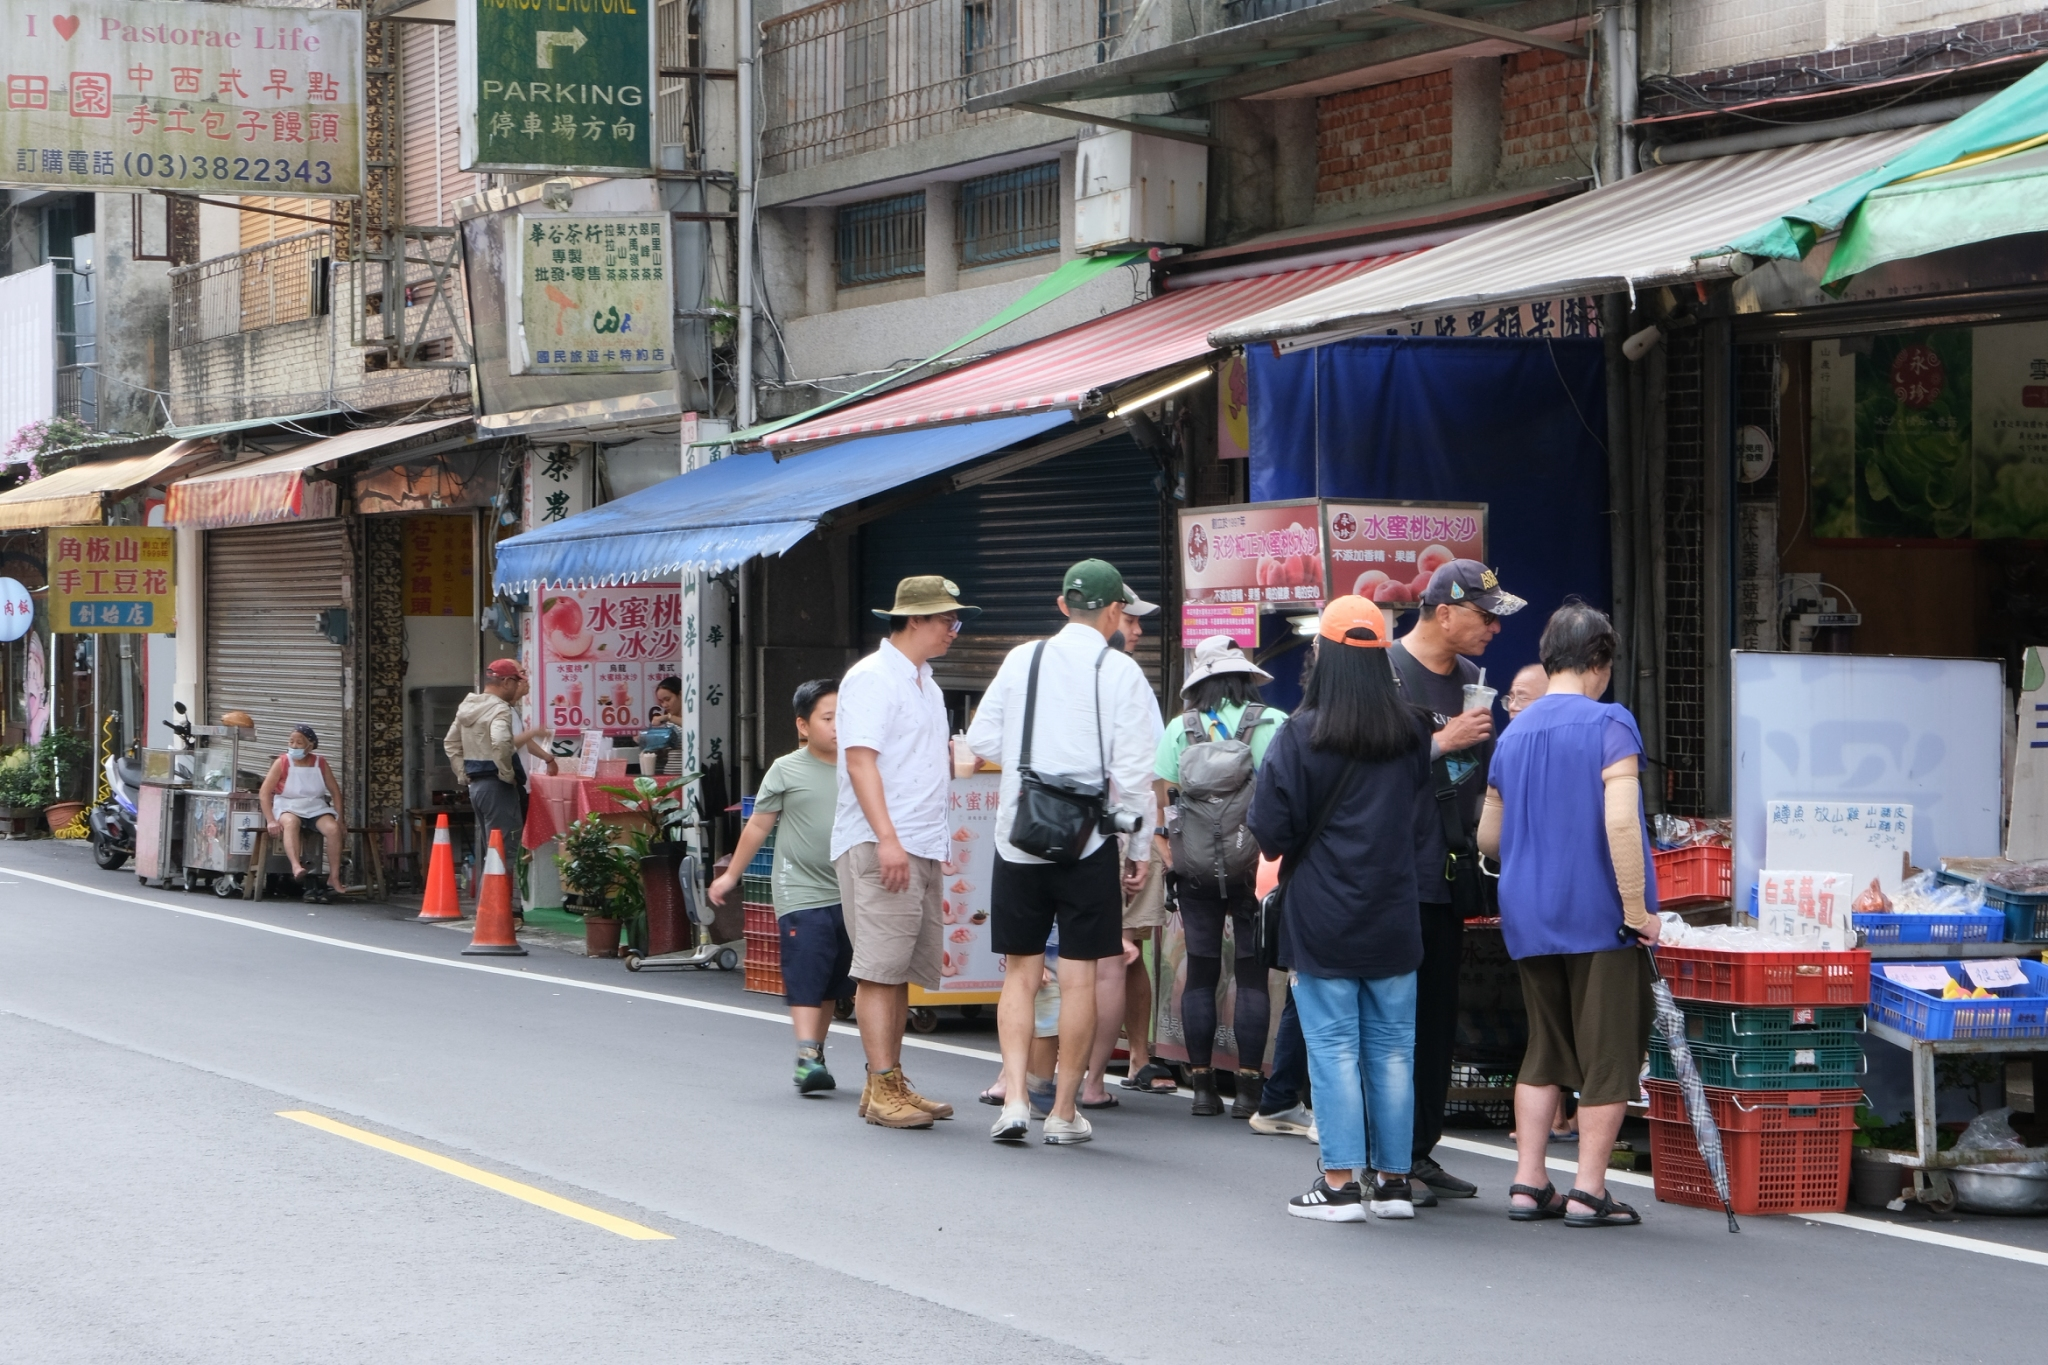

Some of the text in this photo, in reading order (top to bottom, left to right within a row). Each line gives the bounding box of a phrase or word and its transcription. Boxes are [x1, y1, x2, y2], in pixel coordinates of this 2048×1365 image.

[26, 14, 321, 52] I Pastorae Life
[6, 71, 112, 118] 田園
[127, 62, 340, 101] 中西式早點
[483, 80, 642, 106] PARKING
[126, 105, 340, 144] 手工包子饅頭
[489, 111, 636, 142] 停車場方向
[16, 148, 332, 184] 訂購電話 (03)3822343
[528, 222, 603, 247] 華谷茶行
[552, 249, 583, 264] 專製
[536, 348, 665, 364] 國民旅遊卡特約店
[1909, 348, 1930, 404] 永珍
[1363, 513, 1478, 542] 水蜜桃冰沙
[57, 537, 138, 563] 角板山
[57, 569, 168, 594] 手工豆花
[78, 603, 145, 625] 創始店
[585, 594, 682, 631] 水蜜桃
[616, 629, 680, 659] 冰沙
[556, 664, 583, 673] 水蜜桃
[561, 673, 579, 682] 冰沙
[599, 673, 638, 681] 水蜜桃冰沙
[554, 707, 583, 726] 50
[601, 706, 631, 726] 60
[950, 791, 1000, 811] 水蜜桃
